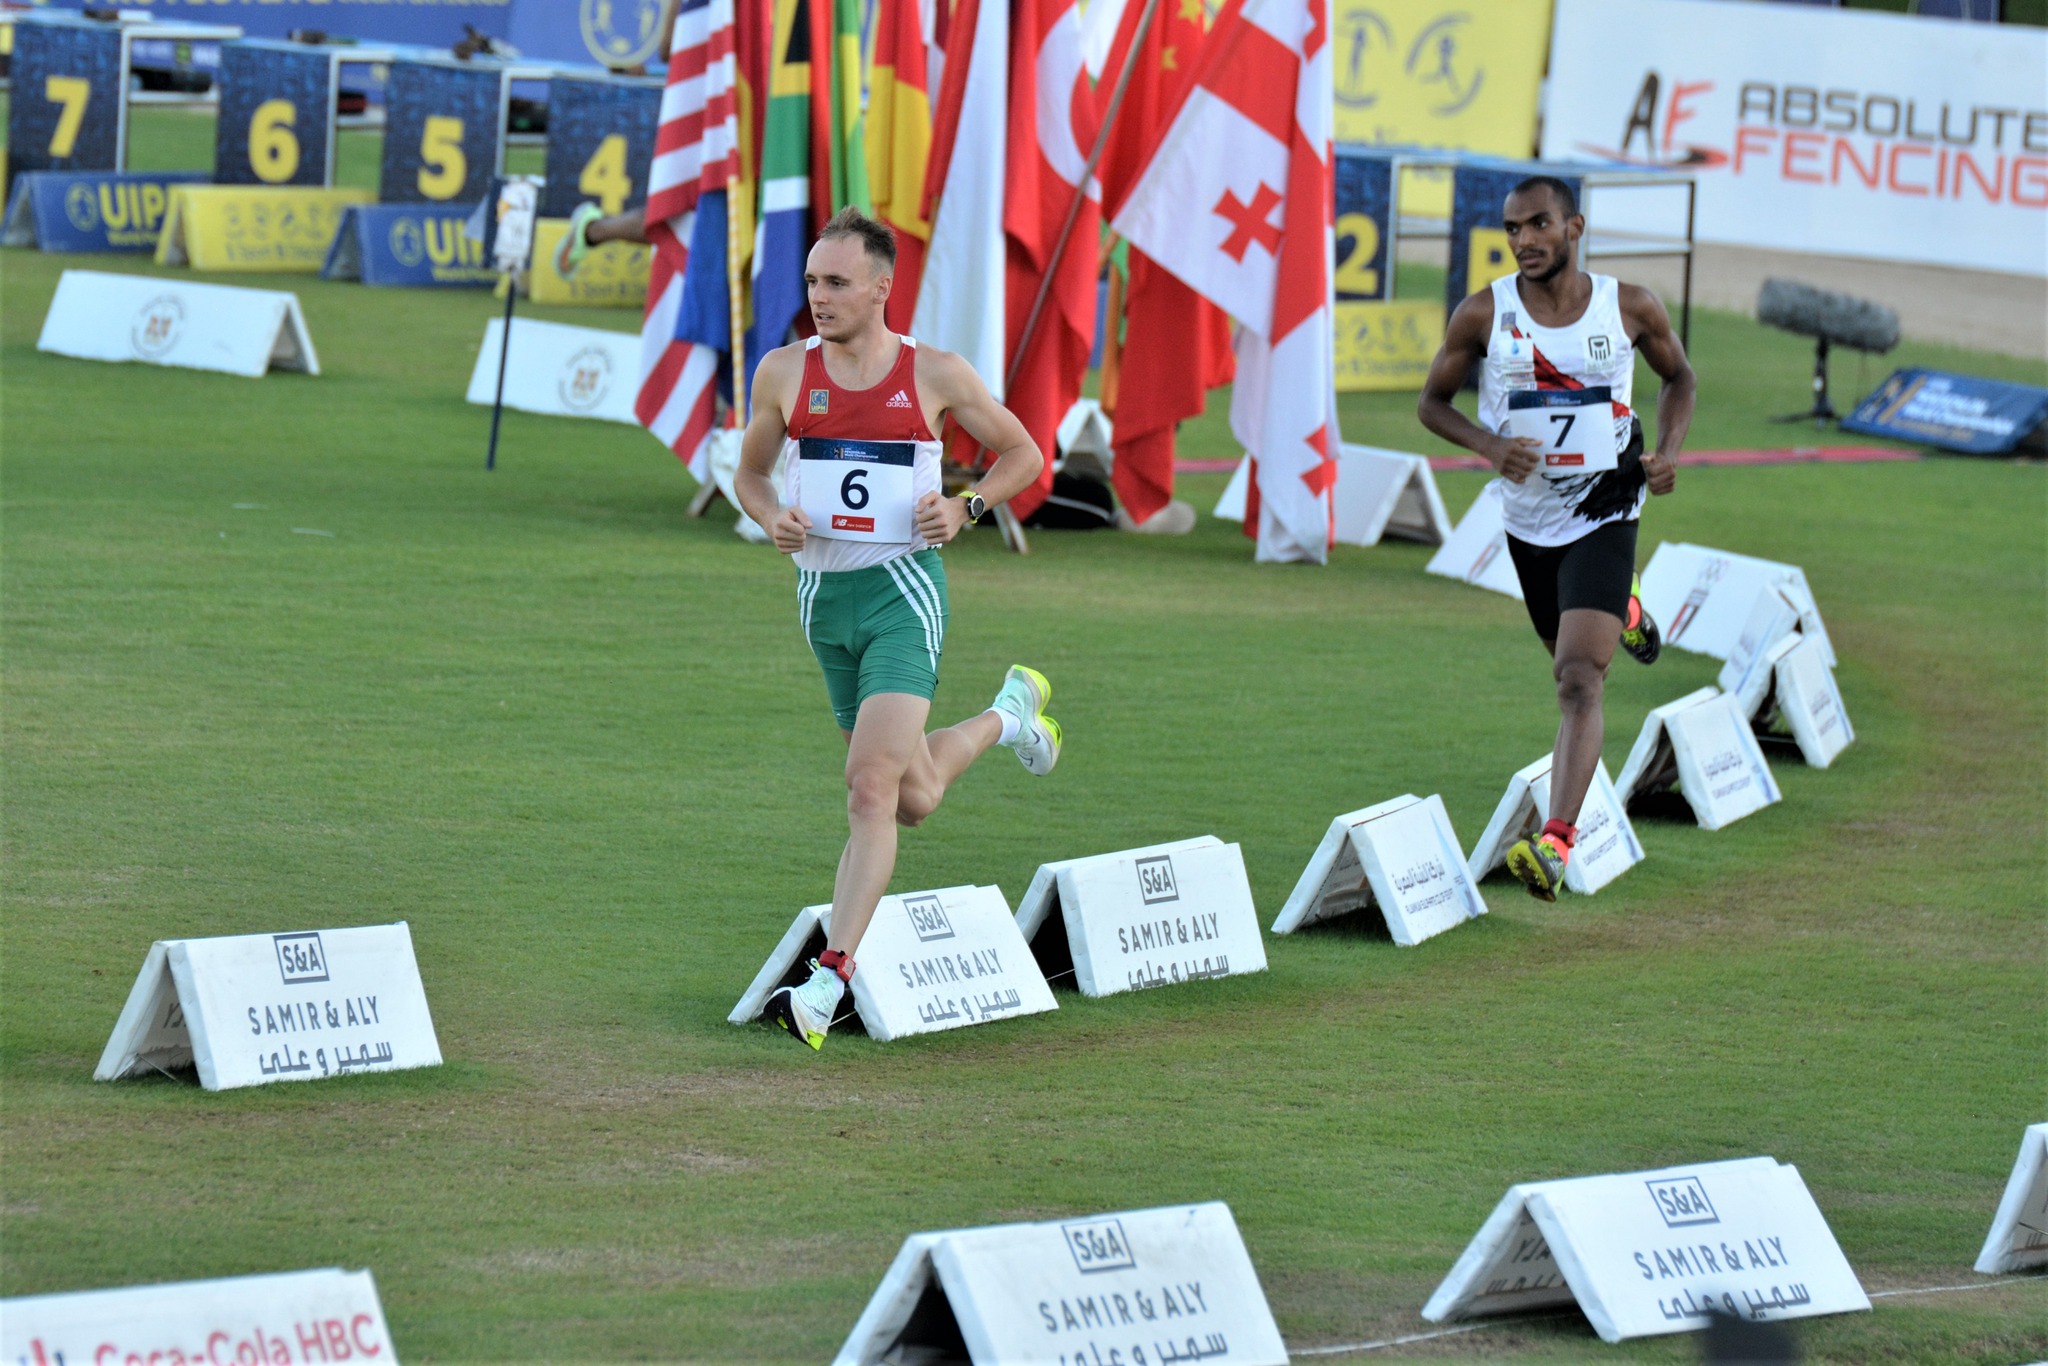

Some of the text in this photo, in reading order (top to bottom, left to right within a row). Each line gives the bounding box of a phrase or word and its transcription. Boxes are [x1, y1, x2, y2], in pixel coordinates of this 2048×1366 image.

[45, 75, 91, 158] 7
[1738, 82, 2048, 152] ABSOLUTE
[248, 99, 299, 183] 6
[417, 115, 466, 200] 5
[579, 134, 632, 215] 4
[1732, 126, 2048, 208] FENCING
[99, 183, 166, 230] UIP
[1335, 213, 1379, 295] 2
[886, 401, 912, 409] adidas
[1550, 414, 1576, 448] 7
[841, 468, 870, 510] 6
[1142, 865, 1173, 894] S&A
[911, 904, 948, 932] S&A
[1118, 912, 1219, 954] SAMIR & ALY
[282, 943, 322, 973] S&A
[899, 948, 1003, 989] SAMIR & ALY
[248, 995, 379, 1036] SAMIR & ALY
[960, 997, 975, 1021] و
[316, 1048, 329, 1076] و
[1658, 1184, 1708, 1217] S&A
[1073, 1227, 1125, 1262] S&A
[1633, 1236, 1788, 1280] SAMIR & ALY
[1038, 1282, 1207, 1333] SAMIR & ALY
[293, 1313, 381, 1364] HBC
